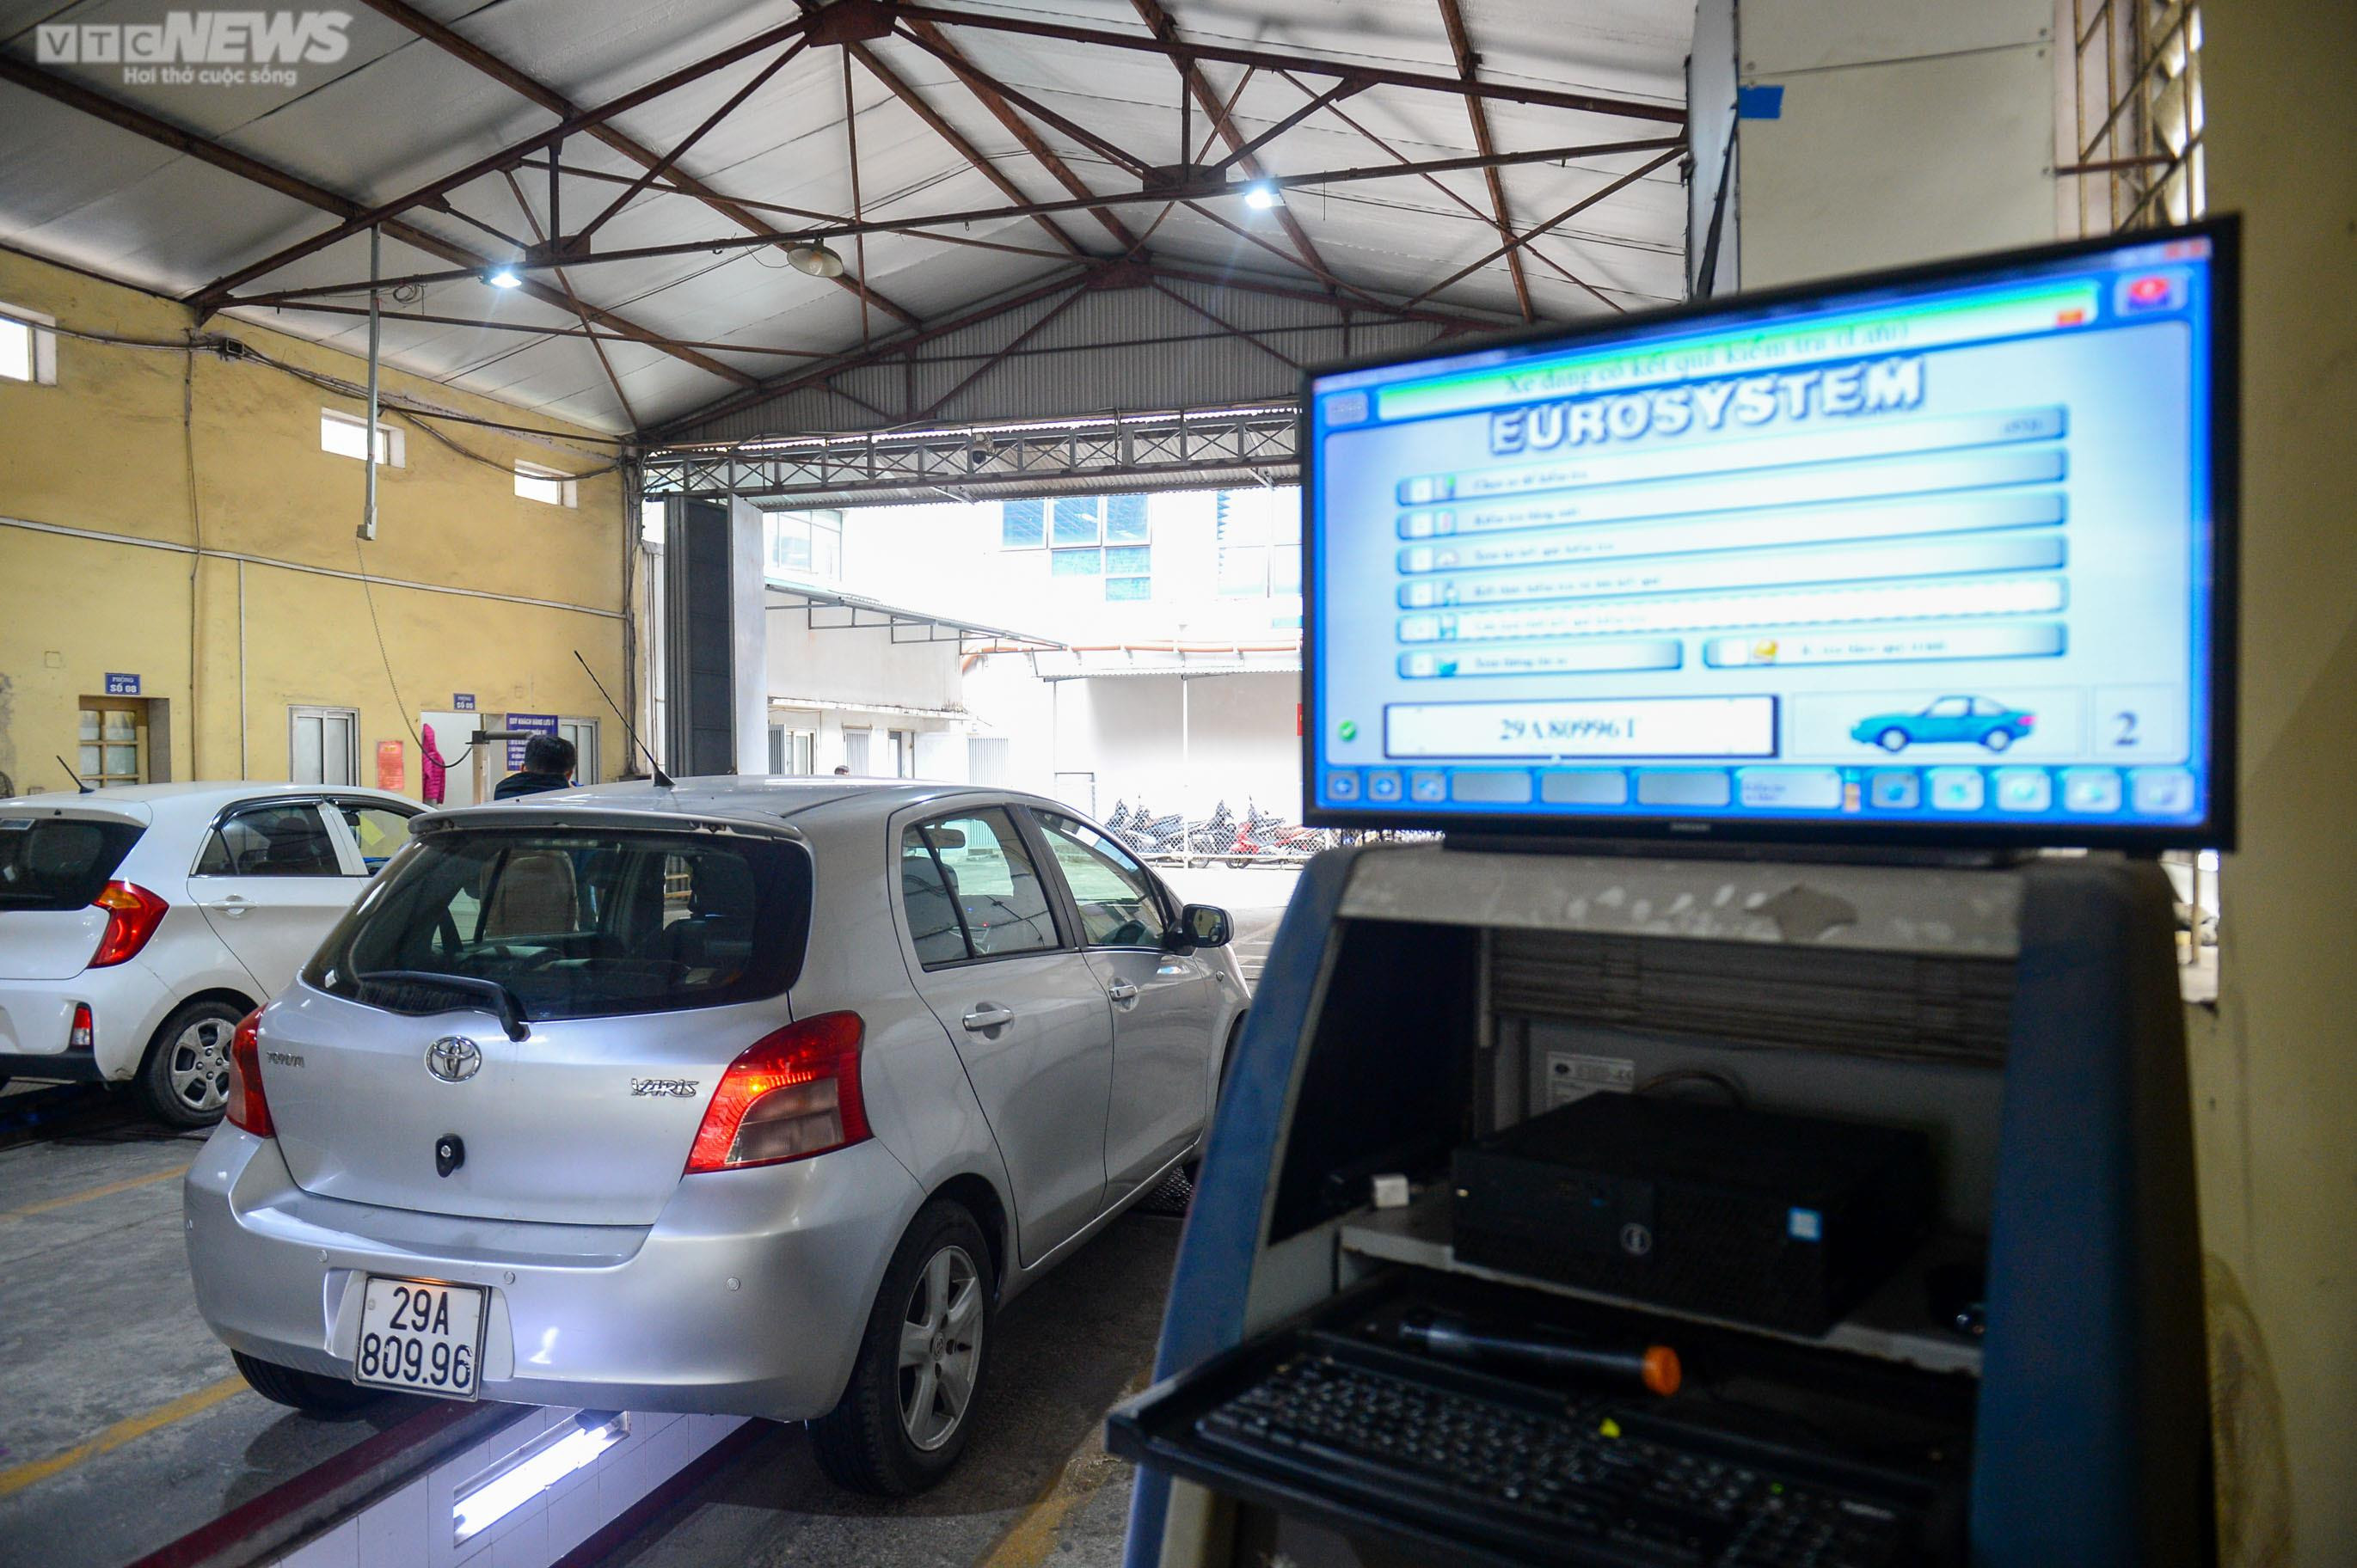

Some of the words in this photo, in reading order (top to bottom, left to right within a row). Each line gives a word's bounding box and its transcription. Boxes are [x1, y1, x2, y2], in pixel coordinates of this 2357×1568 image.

[1488, 354, 1925, 456] EUROSYSTEM
[2114, 712, 2141, 747] 2
[631, 1078, 699, 1098] YARIS
[390, 1286, 449, 1335] 29A
[361, 1332, 473, 1388] 809.96
